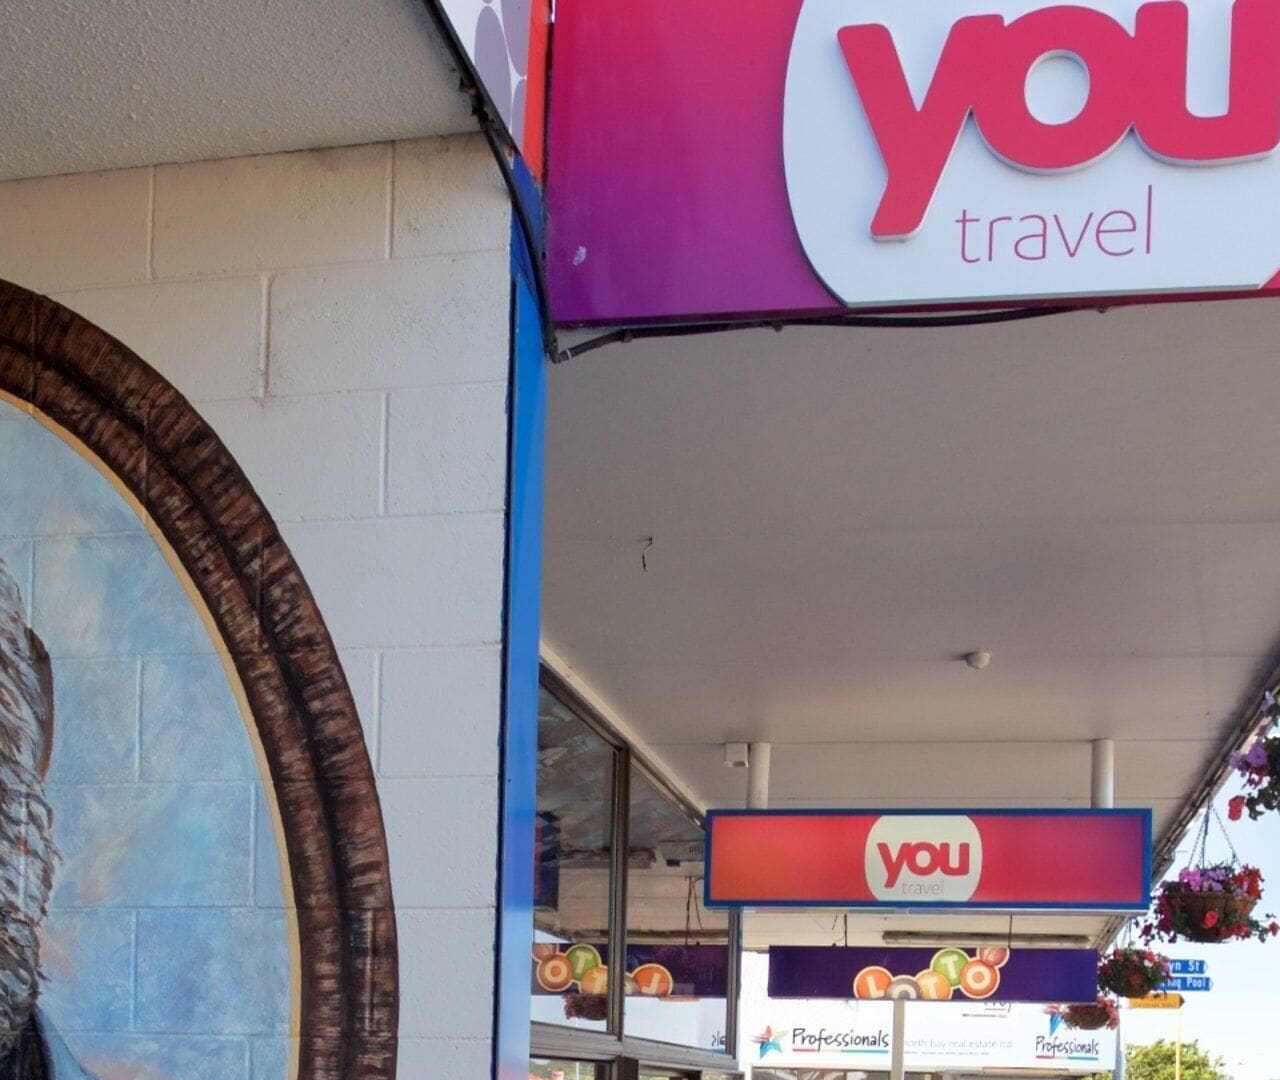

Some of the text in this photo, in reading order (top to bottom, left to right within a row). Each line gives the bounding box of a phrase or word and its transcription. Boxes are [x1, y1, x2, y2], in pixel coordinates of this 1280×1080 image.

[955, 184, 1153, 264] travel
[877, 842, 970, 889] you
[902, 881, 944, 896] travel
[1188, 961, 1200, 971] St
[1187, 977, 1206, 988] Pool
[792, 1028, 889, 1051] Professionals
[1035, 1036, 1099, 1057] Professionals
